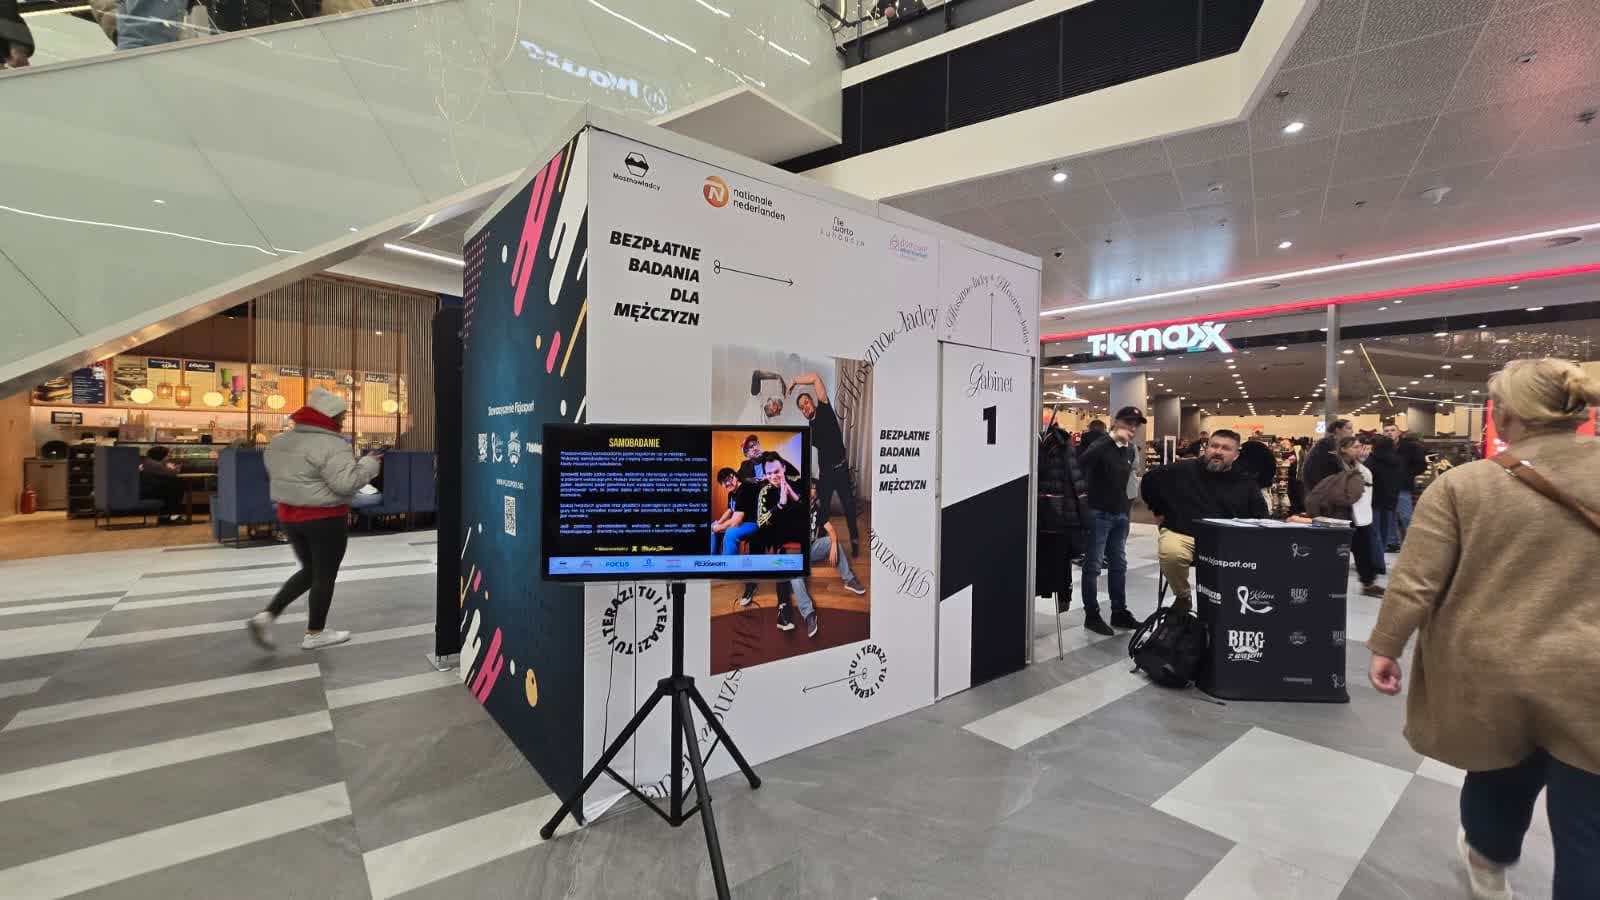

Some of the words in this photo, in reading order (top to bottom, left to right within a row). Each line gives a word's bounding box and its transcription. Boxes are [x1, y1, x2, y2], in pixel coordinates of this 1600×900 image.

[612, 172, 661, 192] Mosznowładcy
[733, 187, 773, 207] nationale
[733, 199, 786, 222] nederlanden
[609, 230, 701, 261] BEZPŁATNE
[628, 257, 700, 283] BADANIA
[670, 287, 699, 304] DLA
[613, 301, 700, 326] MĘŻCZYZN
[967, 361, 1015, 398] Gabinet
[880, 430, 930, 441] BEZPŁATNE
[982, 405, 998, 446] 1
[608, 437, 661, 448] SAMOBADANIE
[880, 447, 920, 457] BADANIA
[879, 464, 898, 474] DLA
[879, 478, 927, 494] MĘŻCZYZN
[638, 586, 656, 600] TU
[602, 587, 633, 637] TERAZ!
[638, 605, 667, 653] TERAZ!
[615, 641, 633, 654] TU
[1228, 630, 1265, 649] BIEG
[861, 644, 887, 665] TERAZ!
[849, 660, 858, 676] TU
[878, 667, 887, 682] TU
[848, 678, 876, 698] TERAZ!
